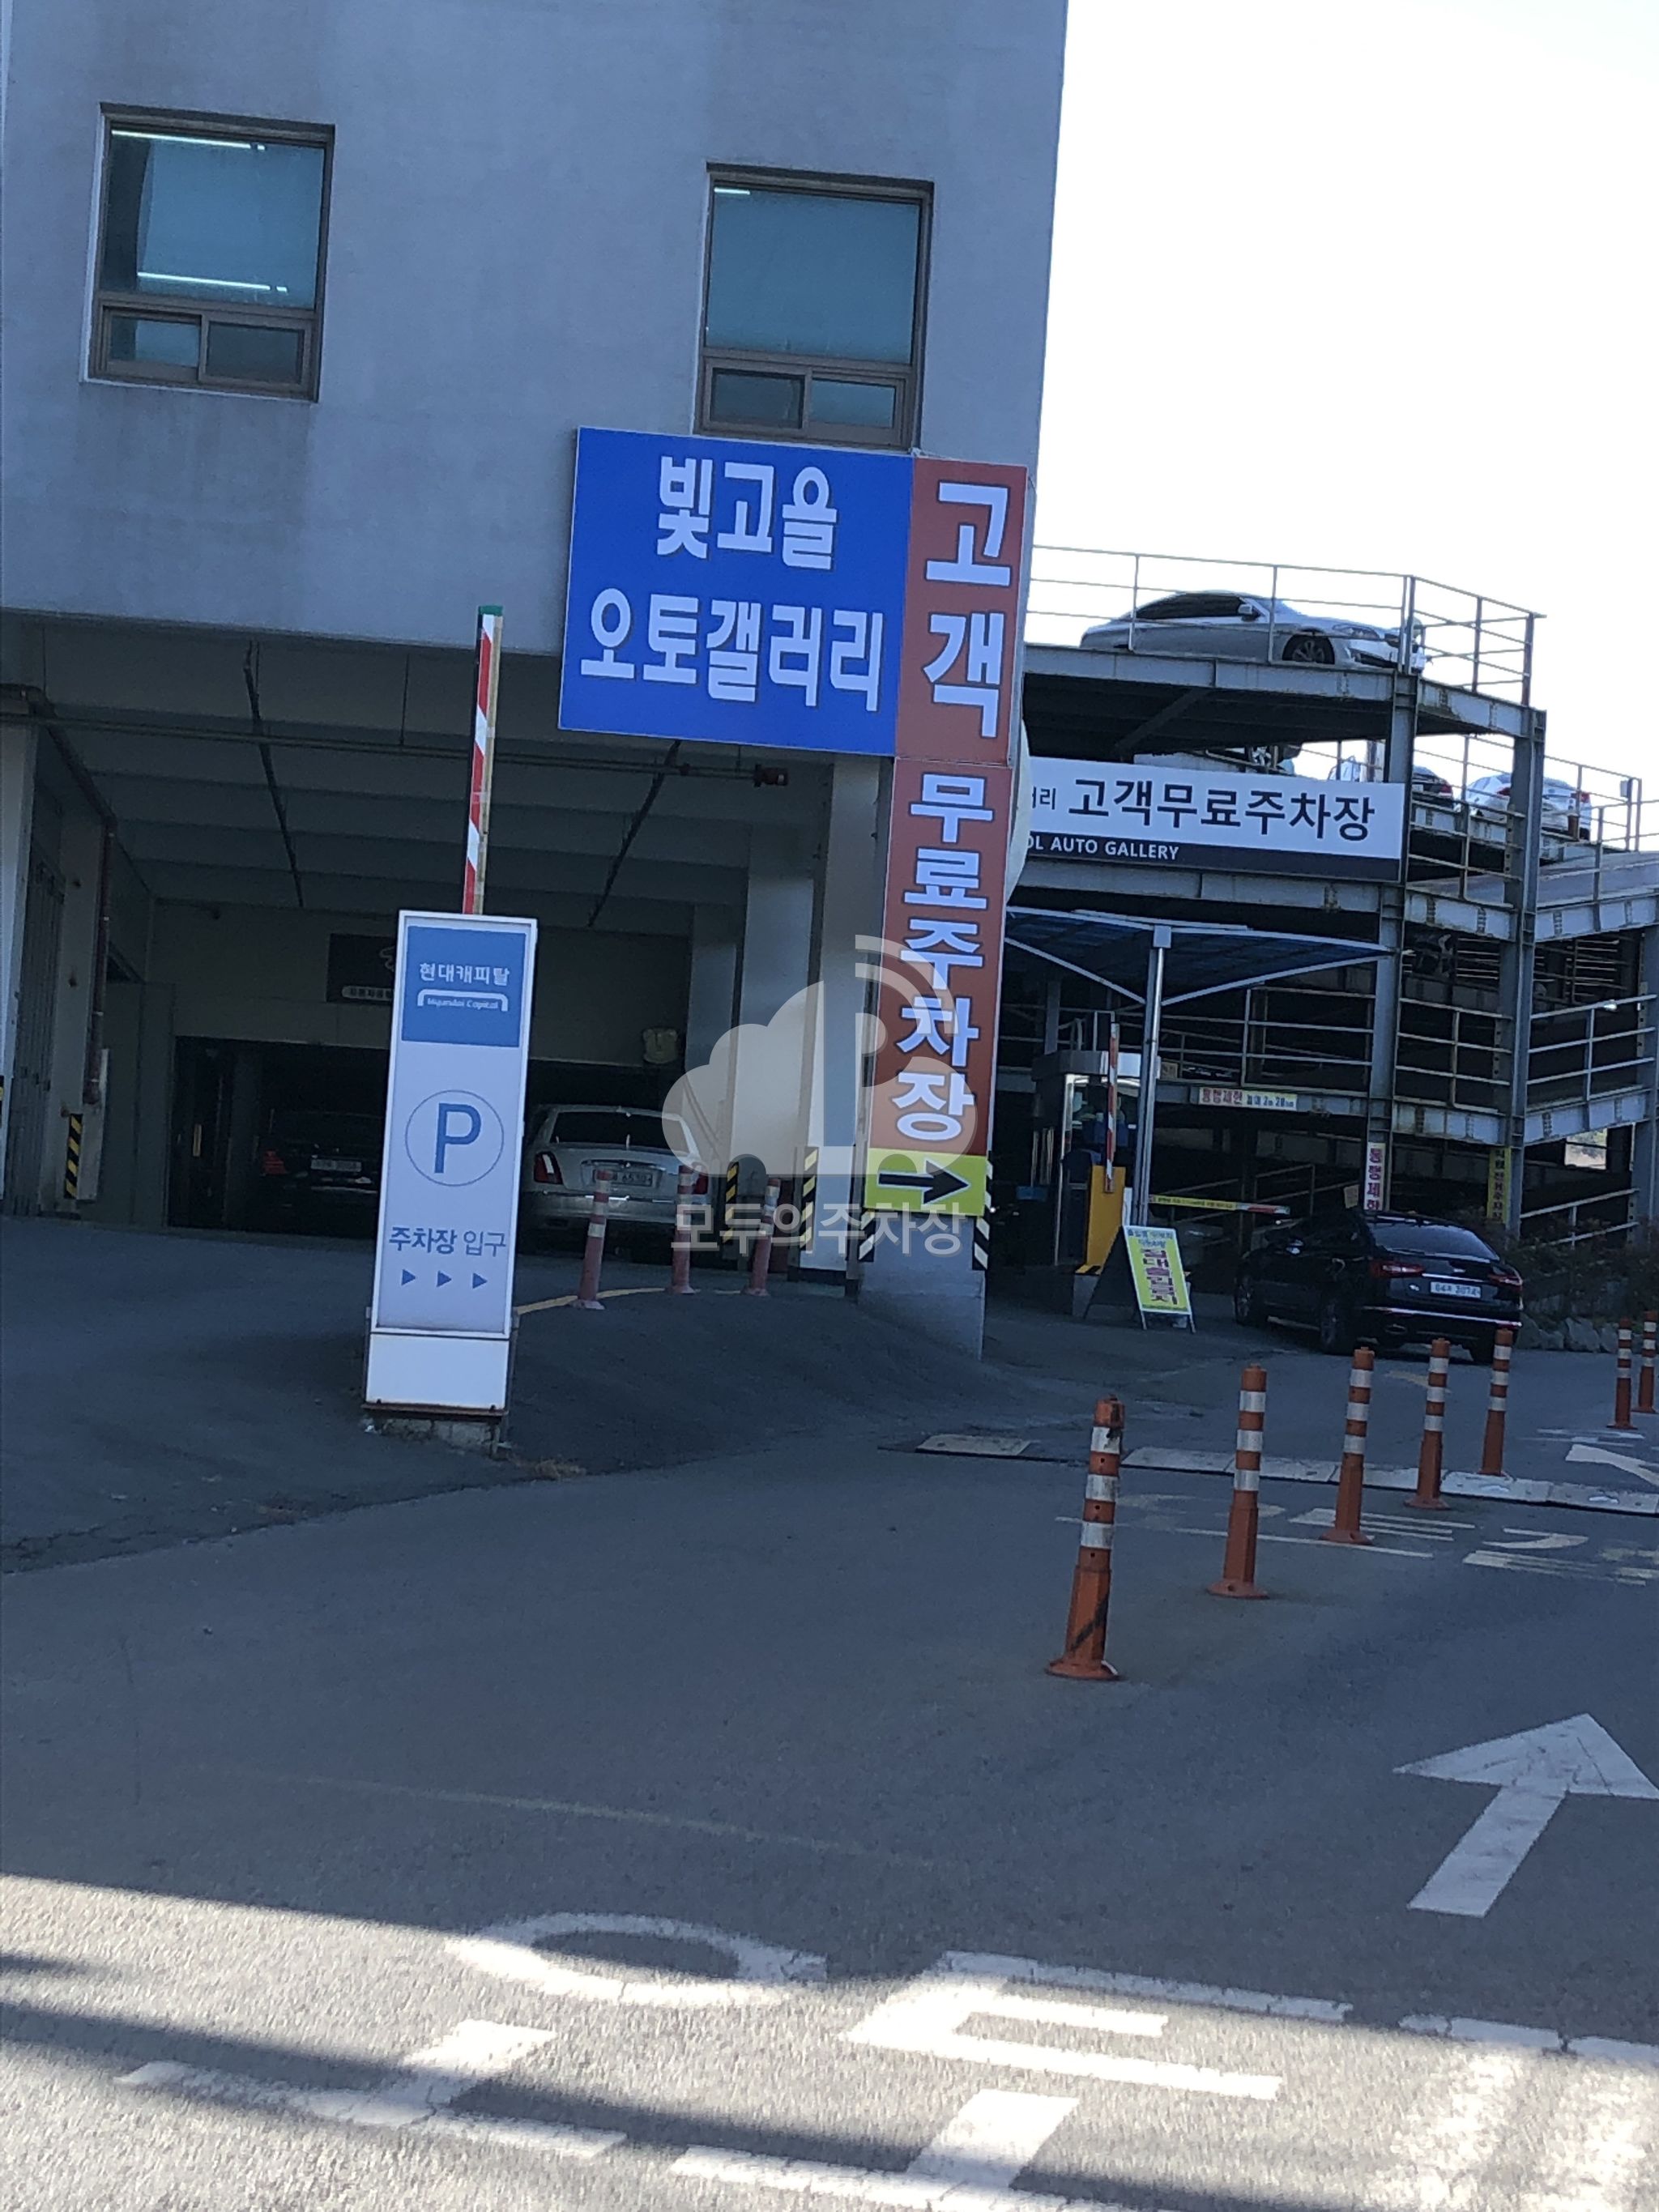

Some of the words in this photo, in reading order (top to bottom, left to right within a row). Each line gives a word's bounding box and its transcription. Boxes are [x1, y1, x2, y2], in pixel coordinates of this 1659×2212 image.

[657, 455, 838, 570] 빛고을
[923, 482, 1011, 739] 고객
[581, 587, 884, 713] 오토갤러리
[1068, 778, 1375, 842] 고객무료주차장
[1051, 836, 1098, 854] AUTO
[1105, 841, 1179, 860] GALLERY
[420, 962, 510, 987] 현대캐피탈
[893, 773, 993, 1141] 무료주차장
[433, 1102, 482, 1174] P
[389, 1226, 458, 1255] 주차장
[463, 1230, 506, 1257] 입구
